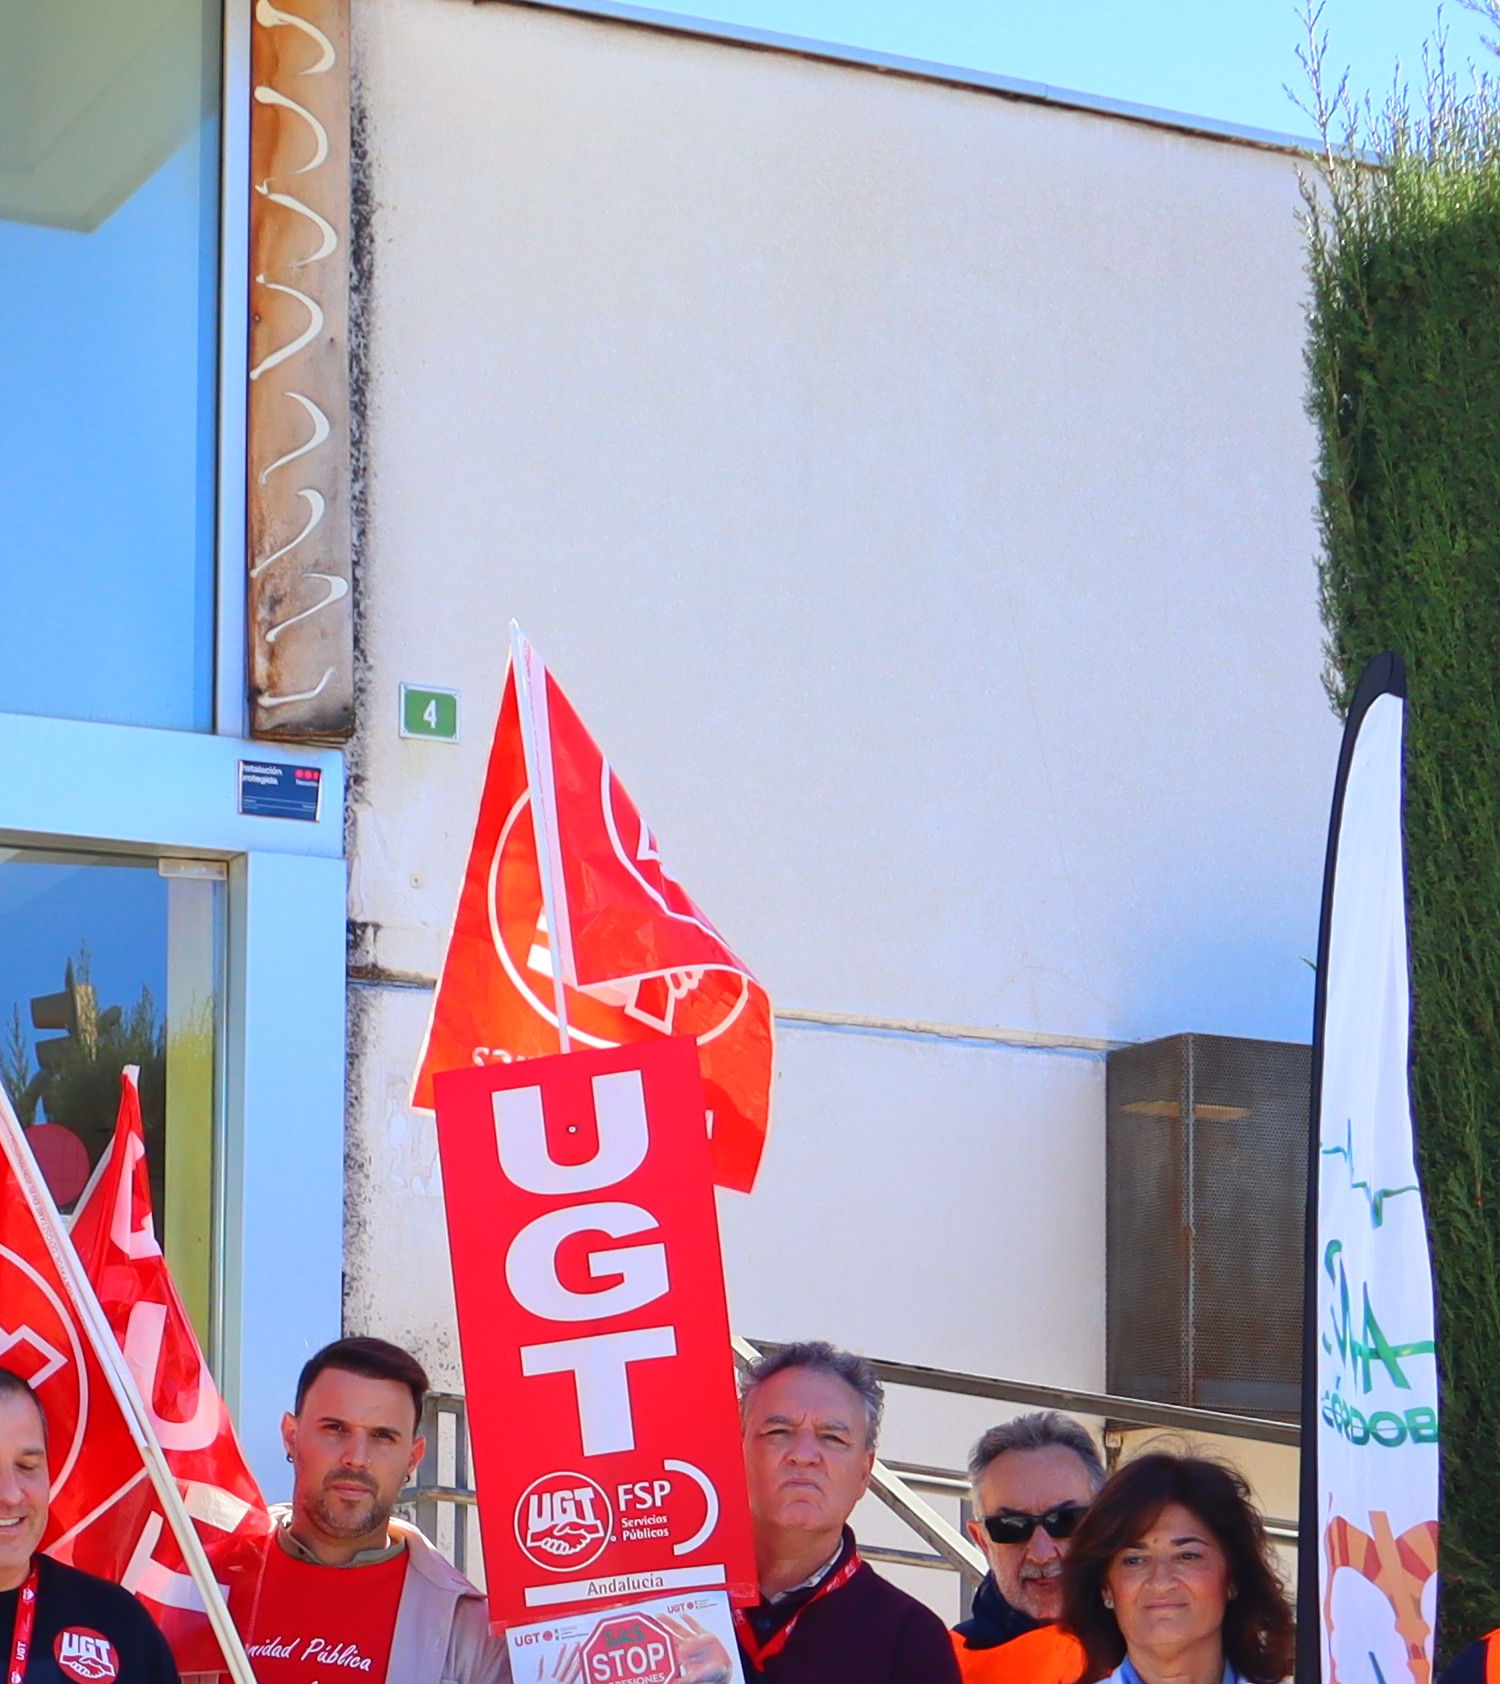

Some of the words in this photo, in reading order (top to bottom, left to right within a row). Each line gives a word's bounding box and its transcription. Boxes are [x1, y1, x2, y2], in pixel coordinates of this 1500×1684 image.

[423, 699, 438, 730] 4
[491, 1069, 678, 1457] UGT
[528, 1486, 595, 1530] UGT
[617, 1480, 672, 1512] FSP
[621, 1515, 669, 1529] Servicios
[622, 1527, 670, 1542] Públicos
[587, 1573, 664, 1597] Andalucía
[667, 1603, 686, 1614] UGT
[63, 1631, 112, 1666] UGT
[514, 1632, 541, 1648] UGT
[603, 1623, 647, 1648] SAS
[300, 1638, 373, 1672] Pública
[592, 1642, 665, 1682] STOP
